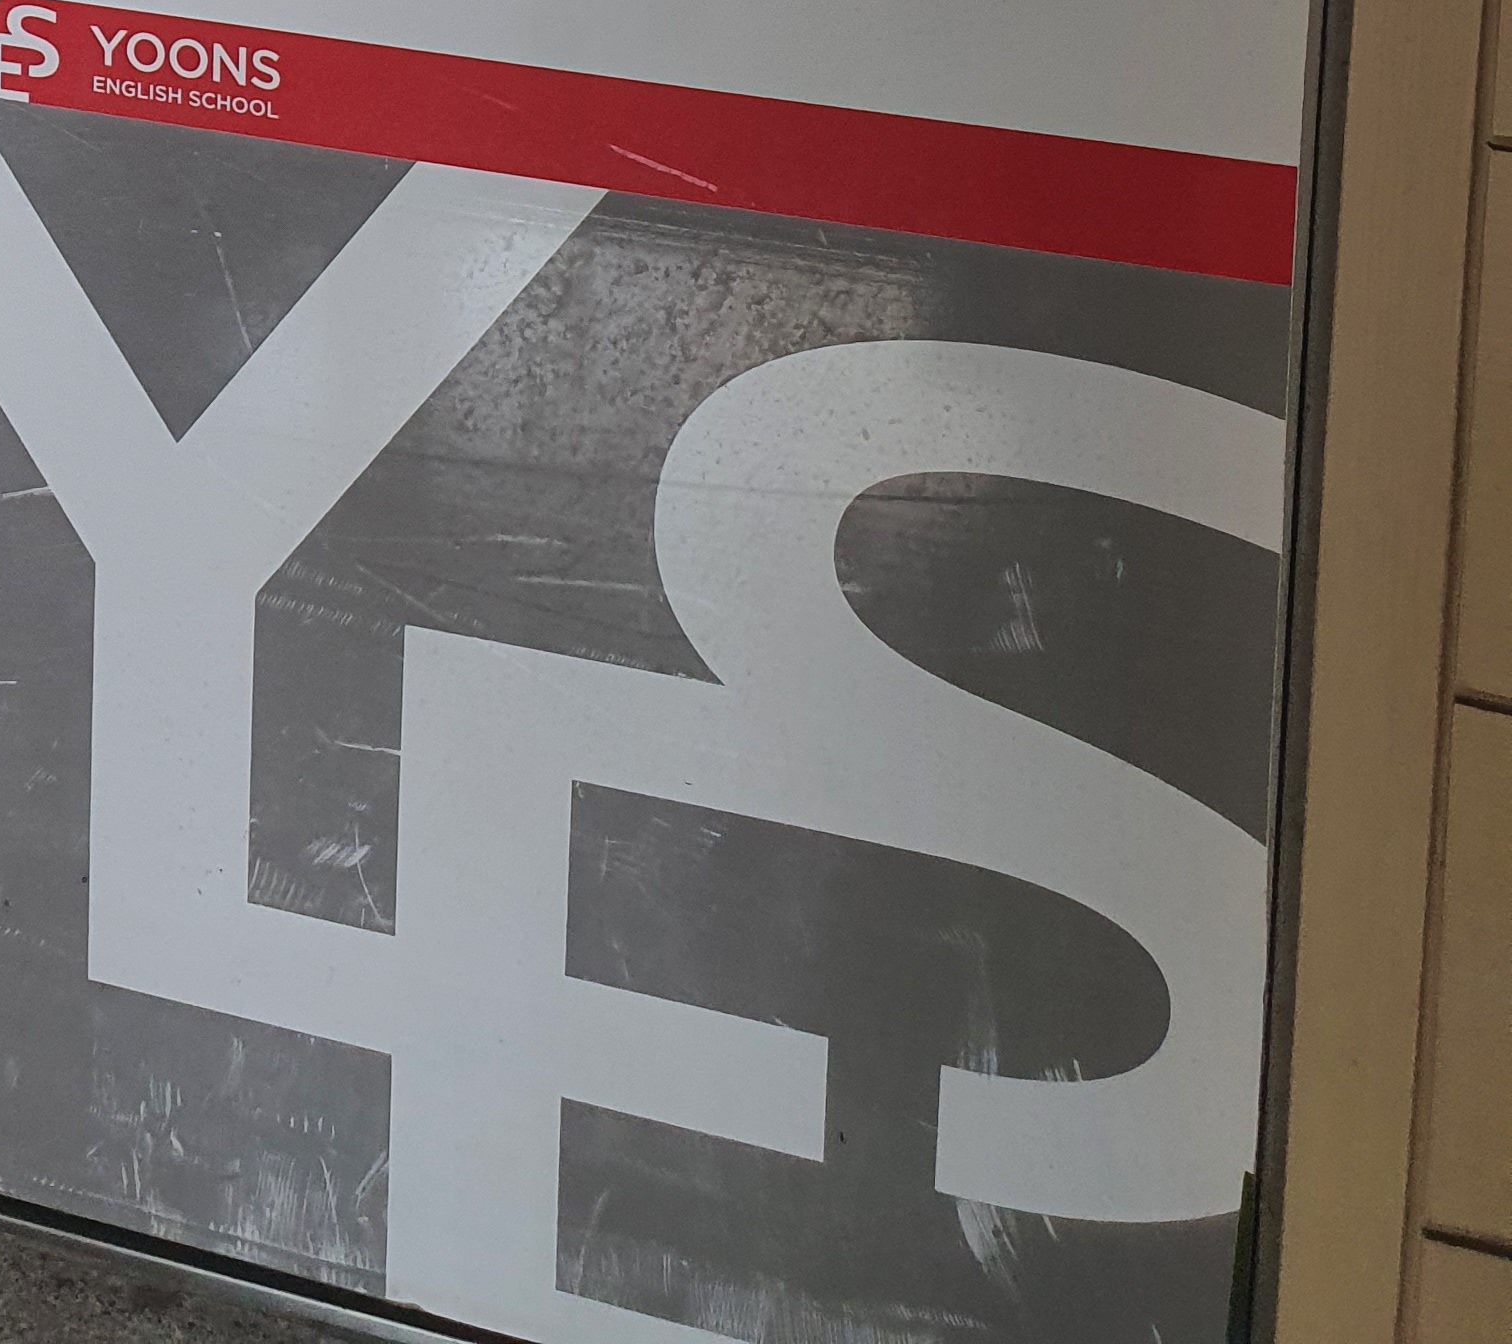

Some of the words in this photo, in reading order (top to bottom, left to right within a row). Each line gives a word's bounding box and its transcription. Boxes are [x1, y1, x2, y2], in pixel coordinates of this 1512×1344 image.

[90, 25, 281, 90] YOONS
[92, 75, 182, 107] ENGLISH
[188, 89, 279, 119] SCHOOL
